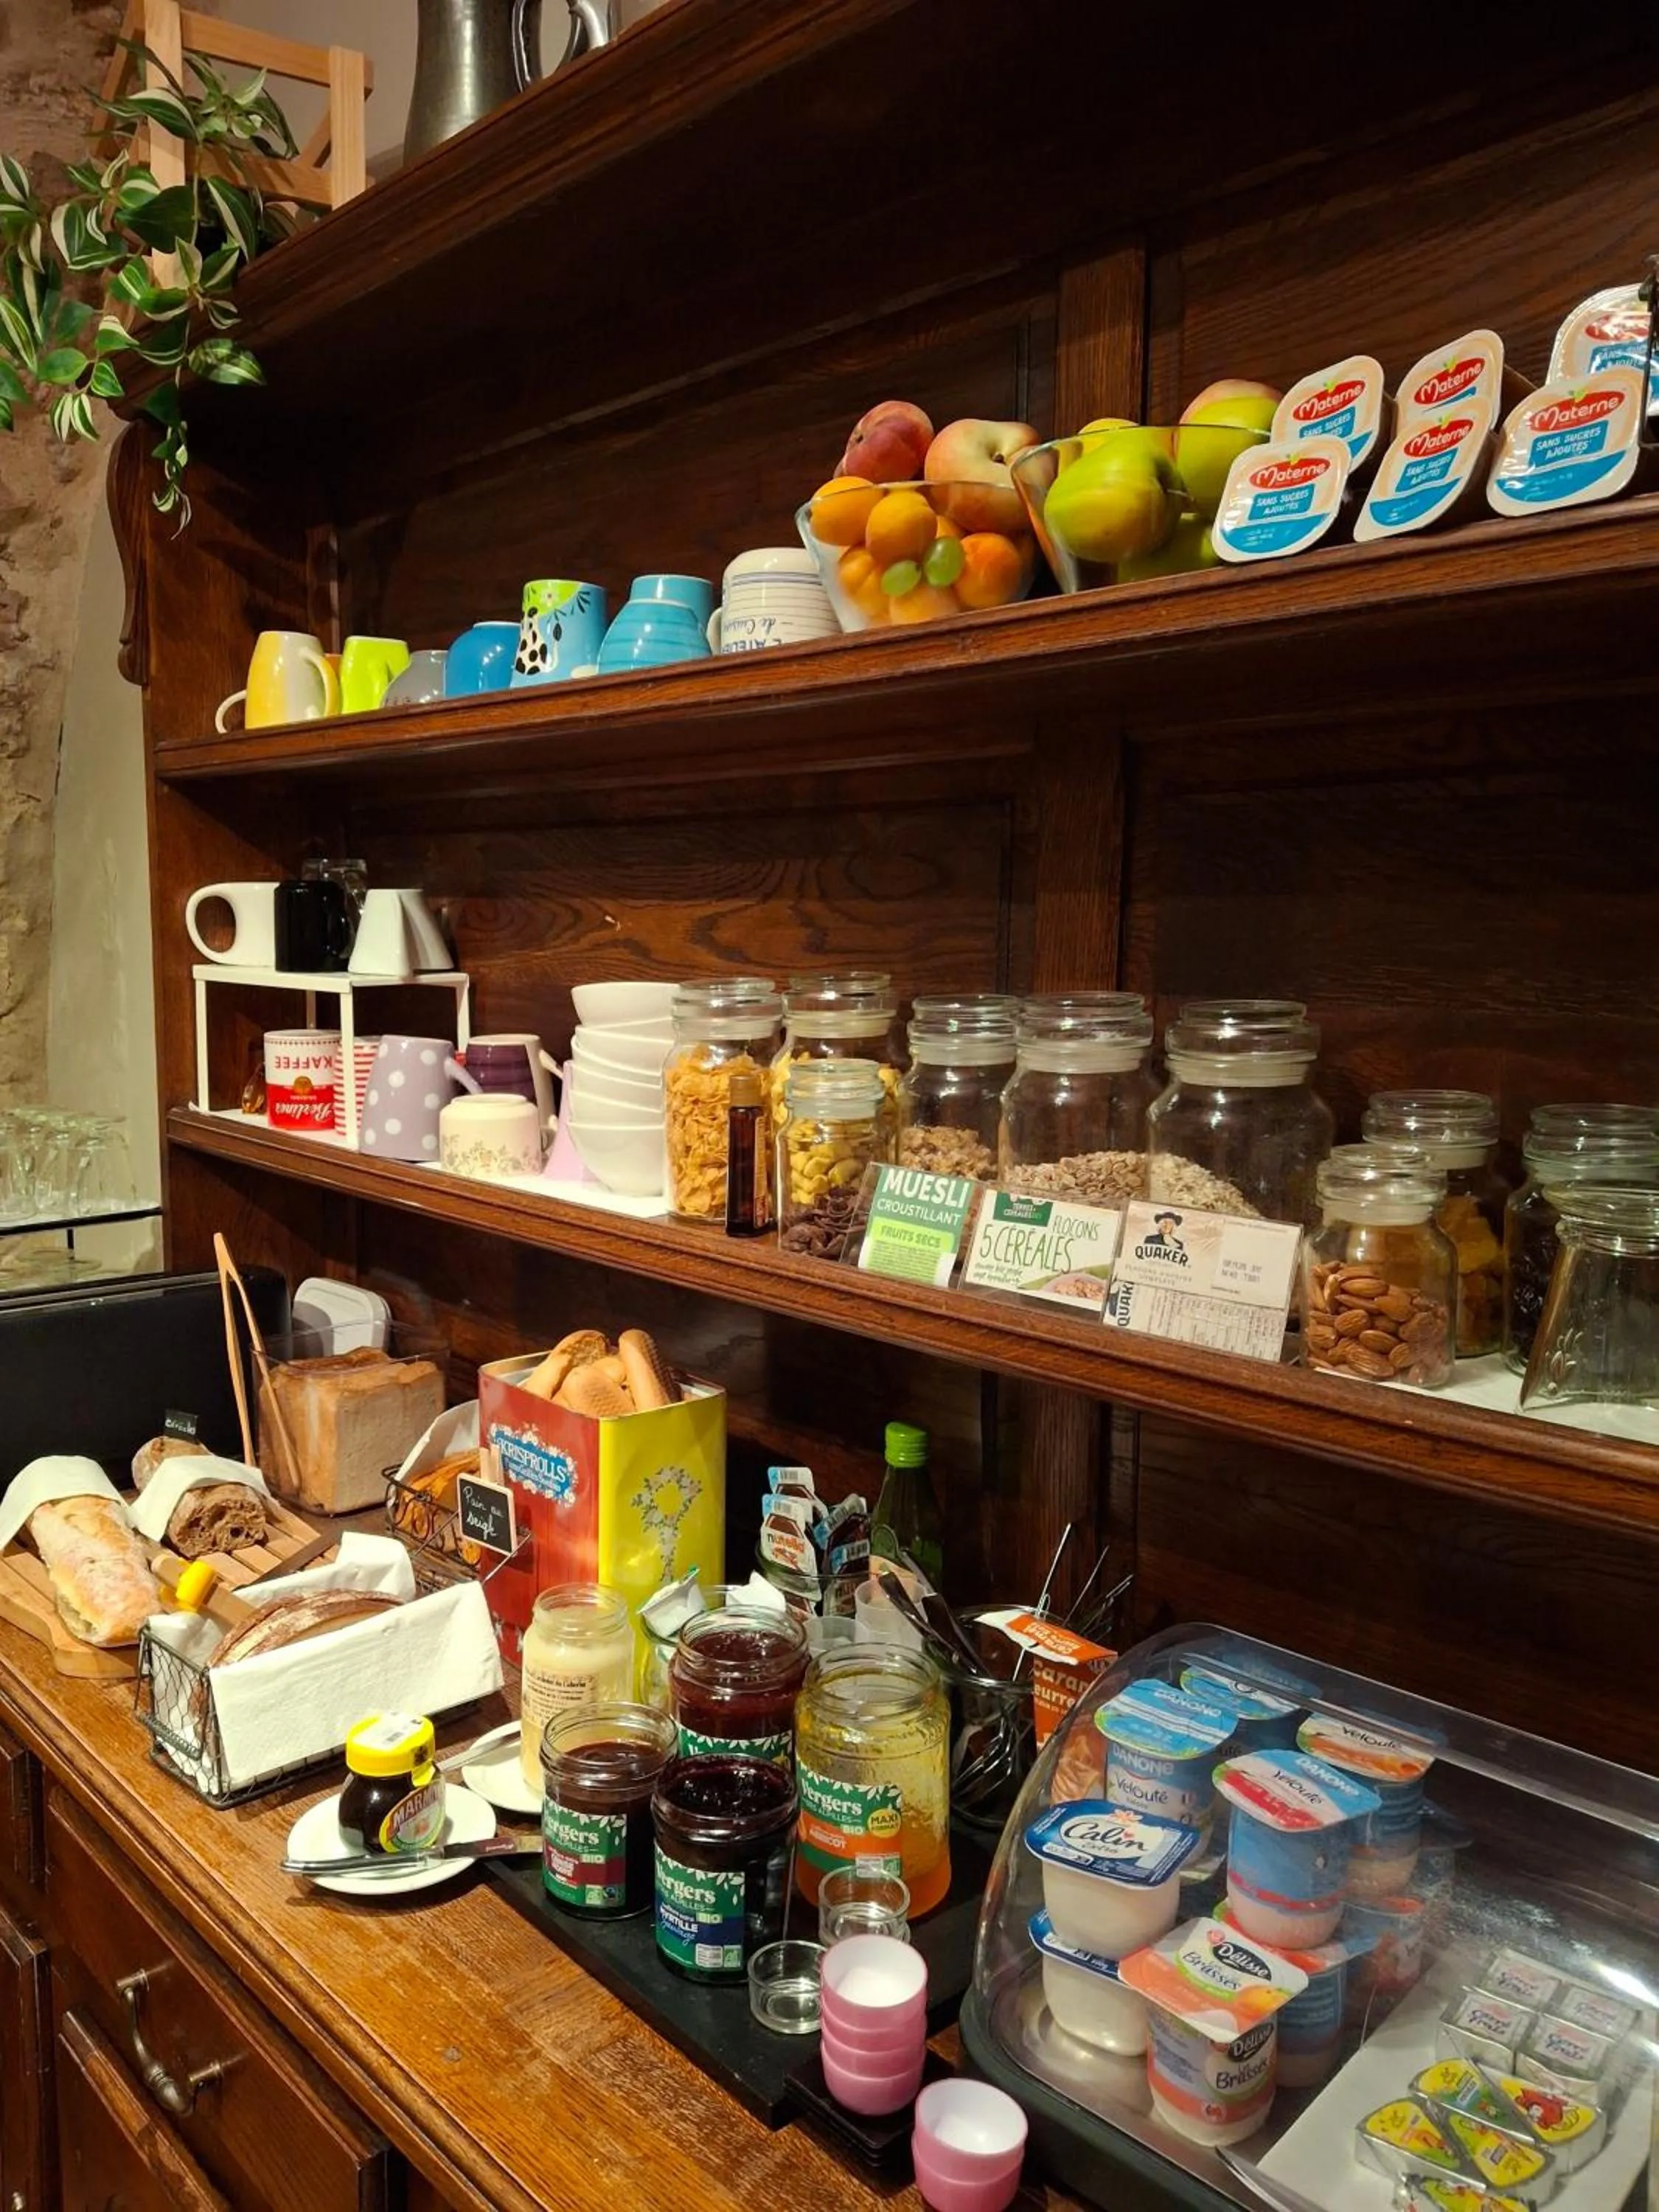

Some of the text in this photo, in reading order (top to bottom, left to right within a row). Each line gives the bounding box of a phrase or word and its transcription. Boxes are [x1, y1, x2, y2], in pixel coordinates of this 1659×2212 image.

[1421, 363, 1482, 402] Materne
[1299, 384, 1363, 418] Materne
[1534, 397, 1620, 430] Materne
[1409, 423, 1471, 457] Materne
[1536, 426, 1601, 451] SANS SUCRES
[1256, 462, 1326, 487] Materne
[274, 1055, 334, 1069] KAFFEE
[275, 1102, 331, 1121] Berliner
[882, 1167, 970, 1209] MUESLI
[877, 1198, 961, 1226] CROUSTILLANT
[880, 1225, 942, 1248] FRUITS SECS
[1051, 1214, 1100, 1241] FLOCONS
[980, 1223, 1075, 1274] 5 CÉRÉALES
[1135, 1245, 1189, 1267] QUAKER
[462, 1486, 487, 1511] Pain
[1033, 1683, 1076, 1708] eurre
[1113, 1743, 1175, 1775] DANONE
[801, 1778, 863, 1815] Vergers
[1116, 1773, 1169, 1804] Velouté
[842, 1824, 865, 1835] BIO
[698, 1913, 722, 1924] BIO
[1217, 1942, 1269, 1978] Délisse
